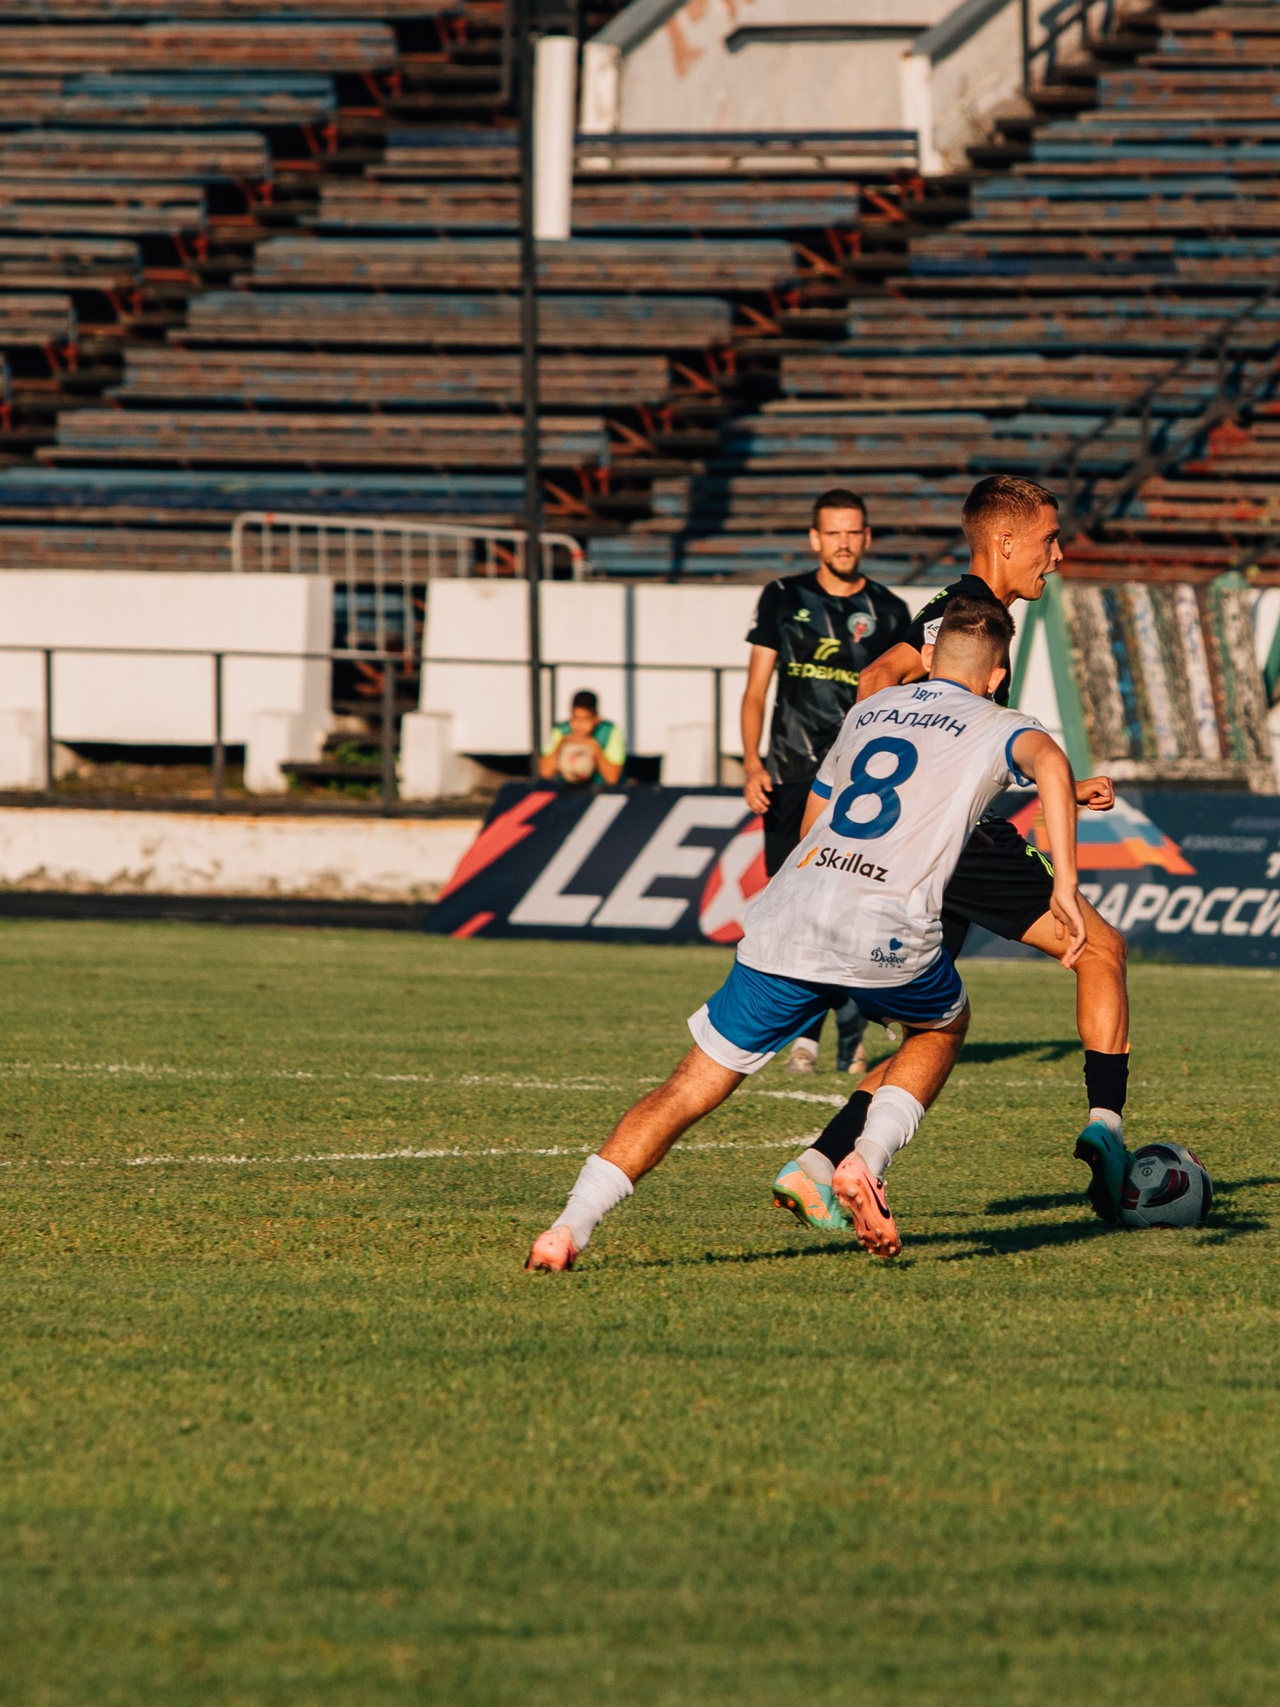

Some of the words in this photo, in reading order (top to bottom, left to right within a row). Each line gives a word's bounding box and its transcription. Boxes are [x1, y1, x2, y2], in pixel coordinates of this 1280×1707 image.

[855, 709, 967, 737] ЮГАЛДИН
[830, 736, 918, 840] 8
[815, 847, 889, 882] Skillaz
